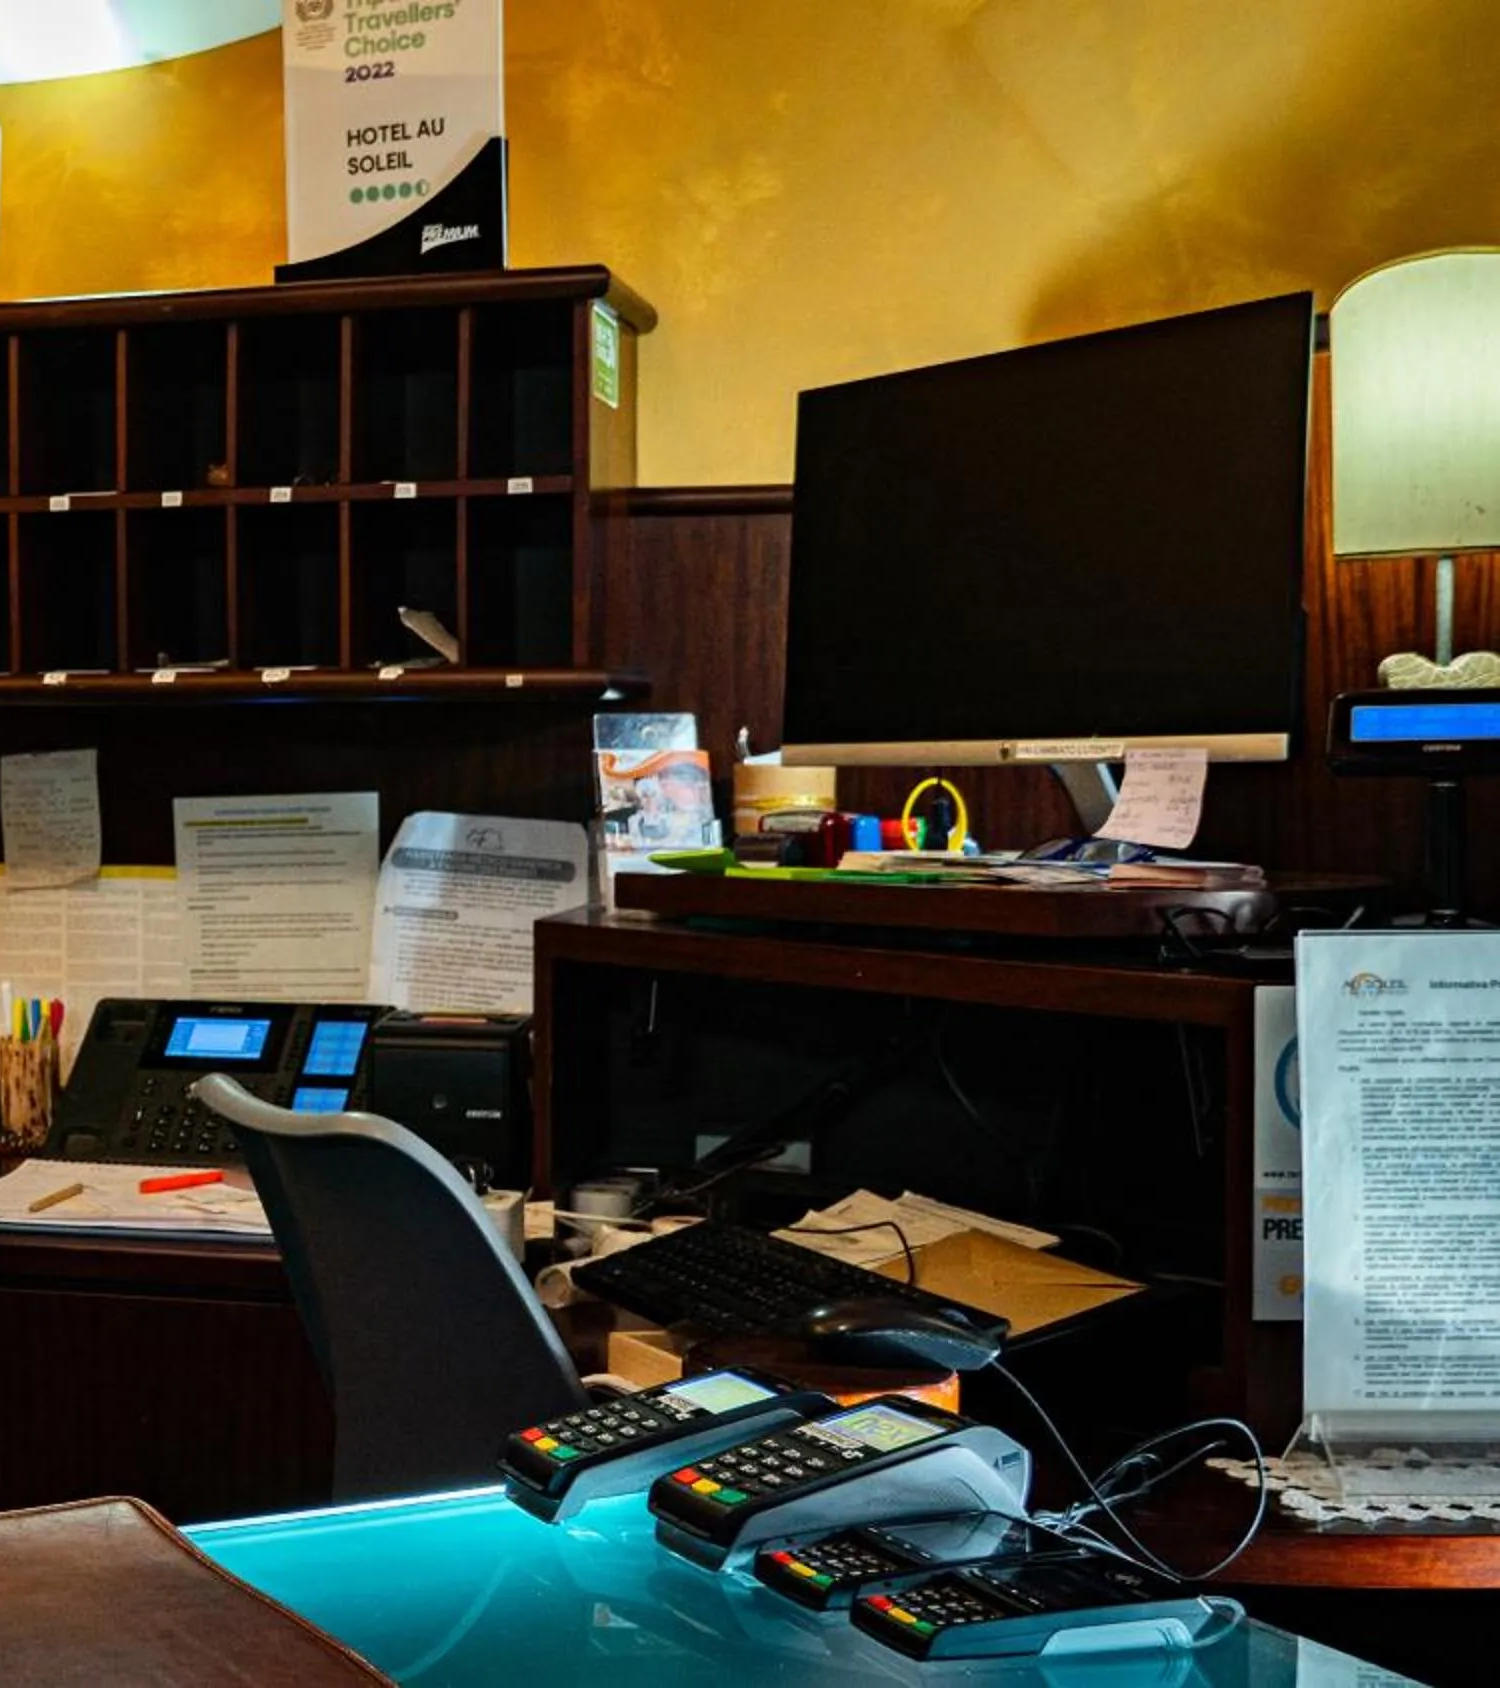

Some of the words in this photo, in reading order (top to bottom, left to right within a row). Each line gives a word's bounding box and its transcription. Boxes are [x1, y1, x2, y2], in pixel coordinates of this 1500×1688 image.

[344, 29, 426, 57] Choice
[345, 61, 395, 83] 2022
[347, 123, 412, 147] HOTEL
[417, 117, 445, 138] AU
[347, 151, 412, 175] SOLEIL
